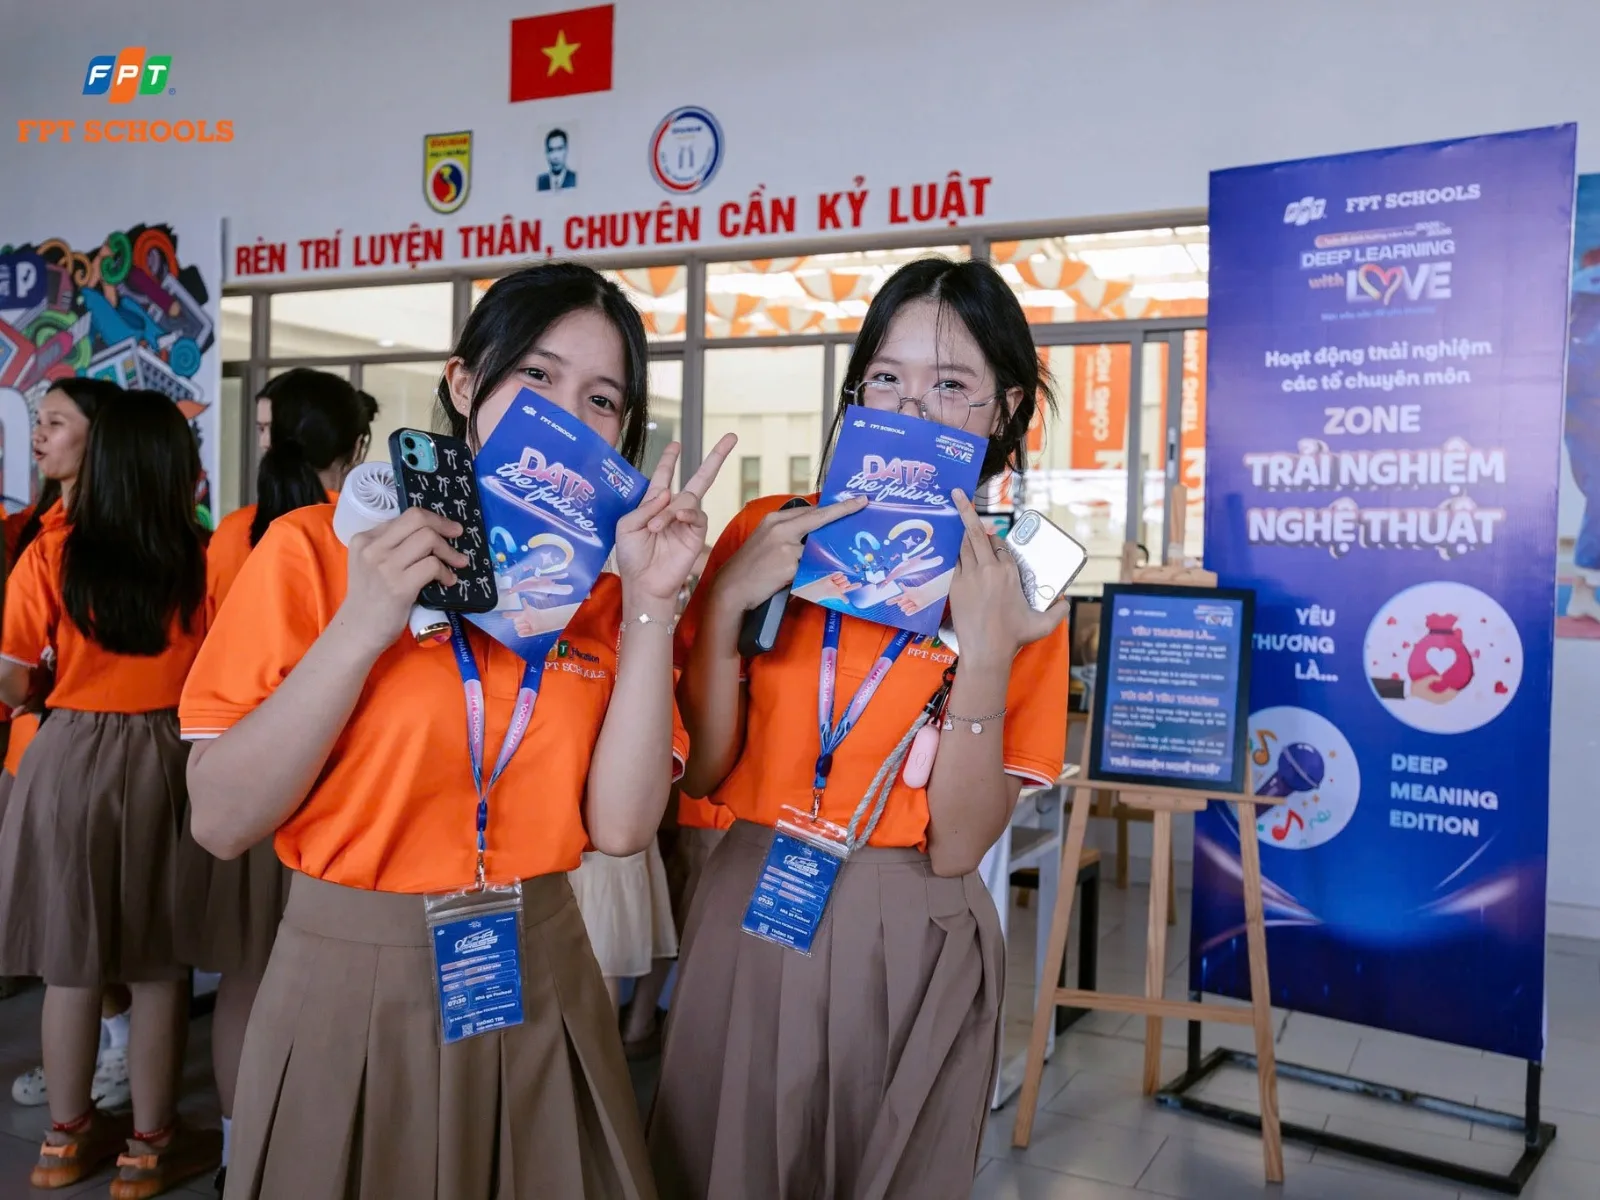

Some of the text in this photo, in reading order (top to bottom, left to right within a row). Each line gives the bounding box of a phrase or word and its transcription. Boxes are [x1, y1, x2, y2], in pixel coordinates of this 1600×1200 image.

[1346, 184, 1481, 213] FPT SCHOOLS
[235, 170, 993, 276] RÈN TRÍ LUYỆN THÂN, CHUYÊN CẦN KỶ LUẬT
[1302, 240, 1455, 267] DEEP LEARNING
[1309, 272, 1344, 288] with
[1265, 348, 1311, 370] Hoạt
[1314, 345, 1364, 369] động
[1412, 337, 1492, 360] nghiệm
[1281, 367, 1470, 392] các tổ chuyên môn
[1324, 405, 1421, 434] ZONE
[518, 447, 596, 507] DATE
[863, 455, 937, 489] DATE
[1246, 438, 1506, 495] TRẢI NGHIỆM
[496, 462, 598, 532] the future
[846, 472, 949, 505] the future
[1248, 497, 1504, 554] NGHỆ THUẬT
[1296, 604, 1335, 627] YÊU
[544, 661, 559, 670] PT
[1391, 753, 1448, 775] DEEP
[1390, 782, 1498, 810] MEANING
[1389, 810, 1480, 837] EDITION
